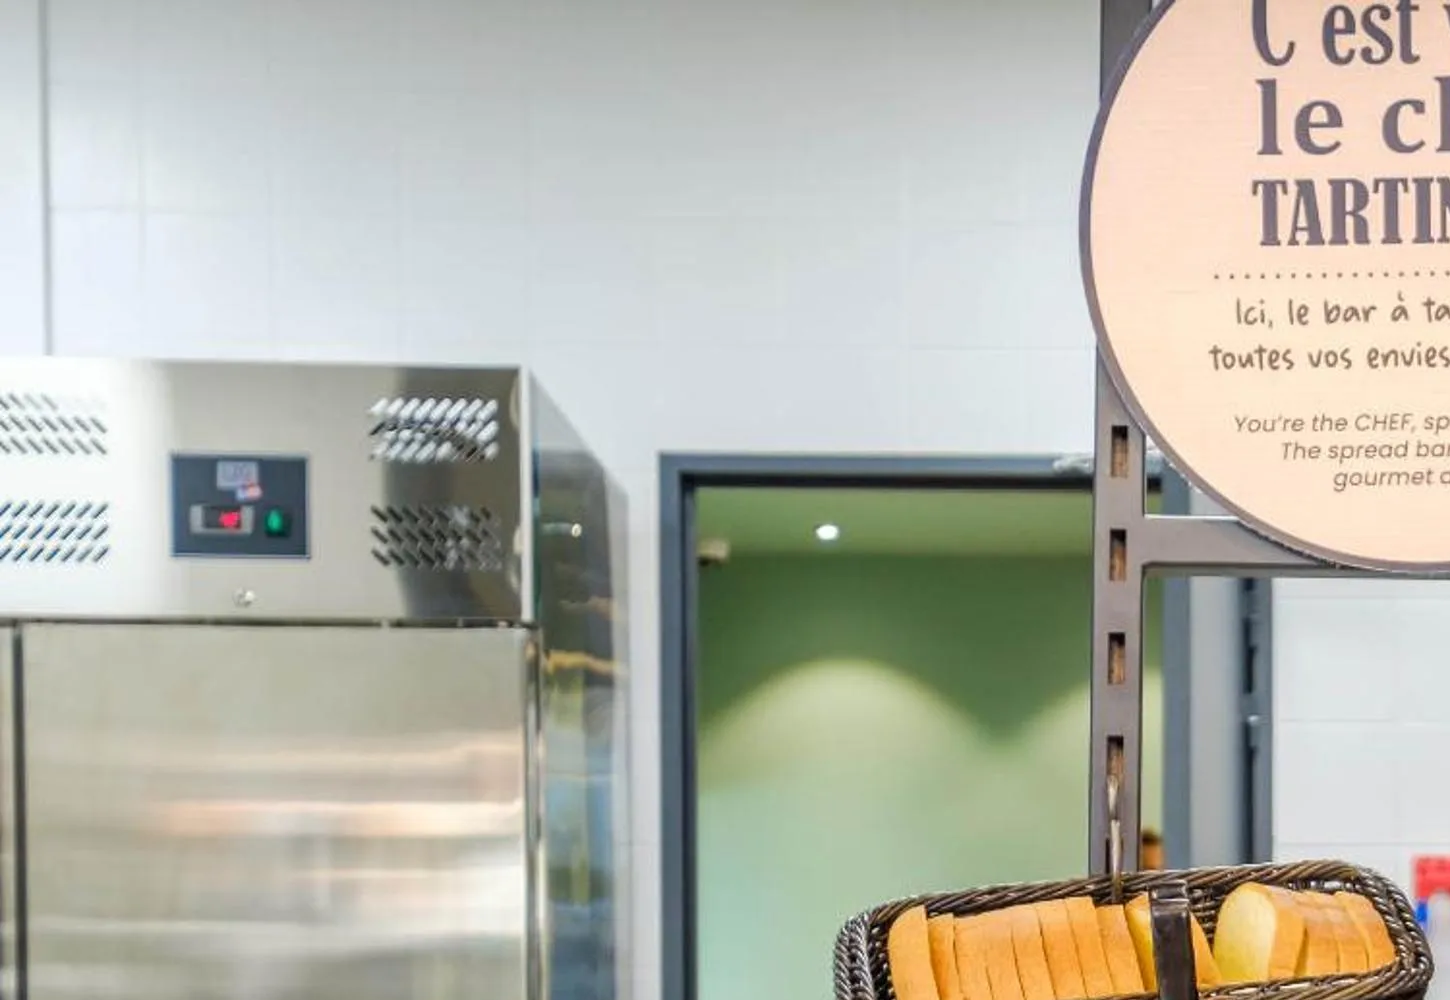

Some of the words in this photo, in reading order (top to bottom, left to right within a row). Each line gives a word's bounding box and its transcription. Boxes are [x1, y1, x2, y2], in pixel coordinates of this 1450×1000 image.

[1255, 77, 1344, 156] le
[1236, 298, 1273, 328] Ici,
[1288, 298, 1310, 326] le
[1323, 300, 1377, 325] bar
[1390, 292, 1409, 322] à
[1208, 344, 1295, 371] toutes
[1307, 347, 1353, 370] vos
[1234, 414, 1306, 434] You're
[1311, 413, 1349, 433] the
[1354, 412, 1416, 433] CHEF,
[1281, 441, 1322, 460] The
[1327, 439, 1409, 465] spread
[1333, 468, 1434, 493] gourmet
